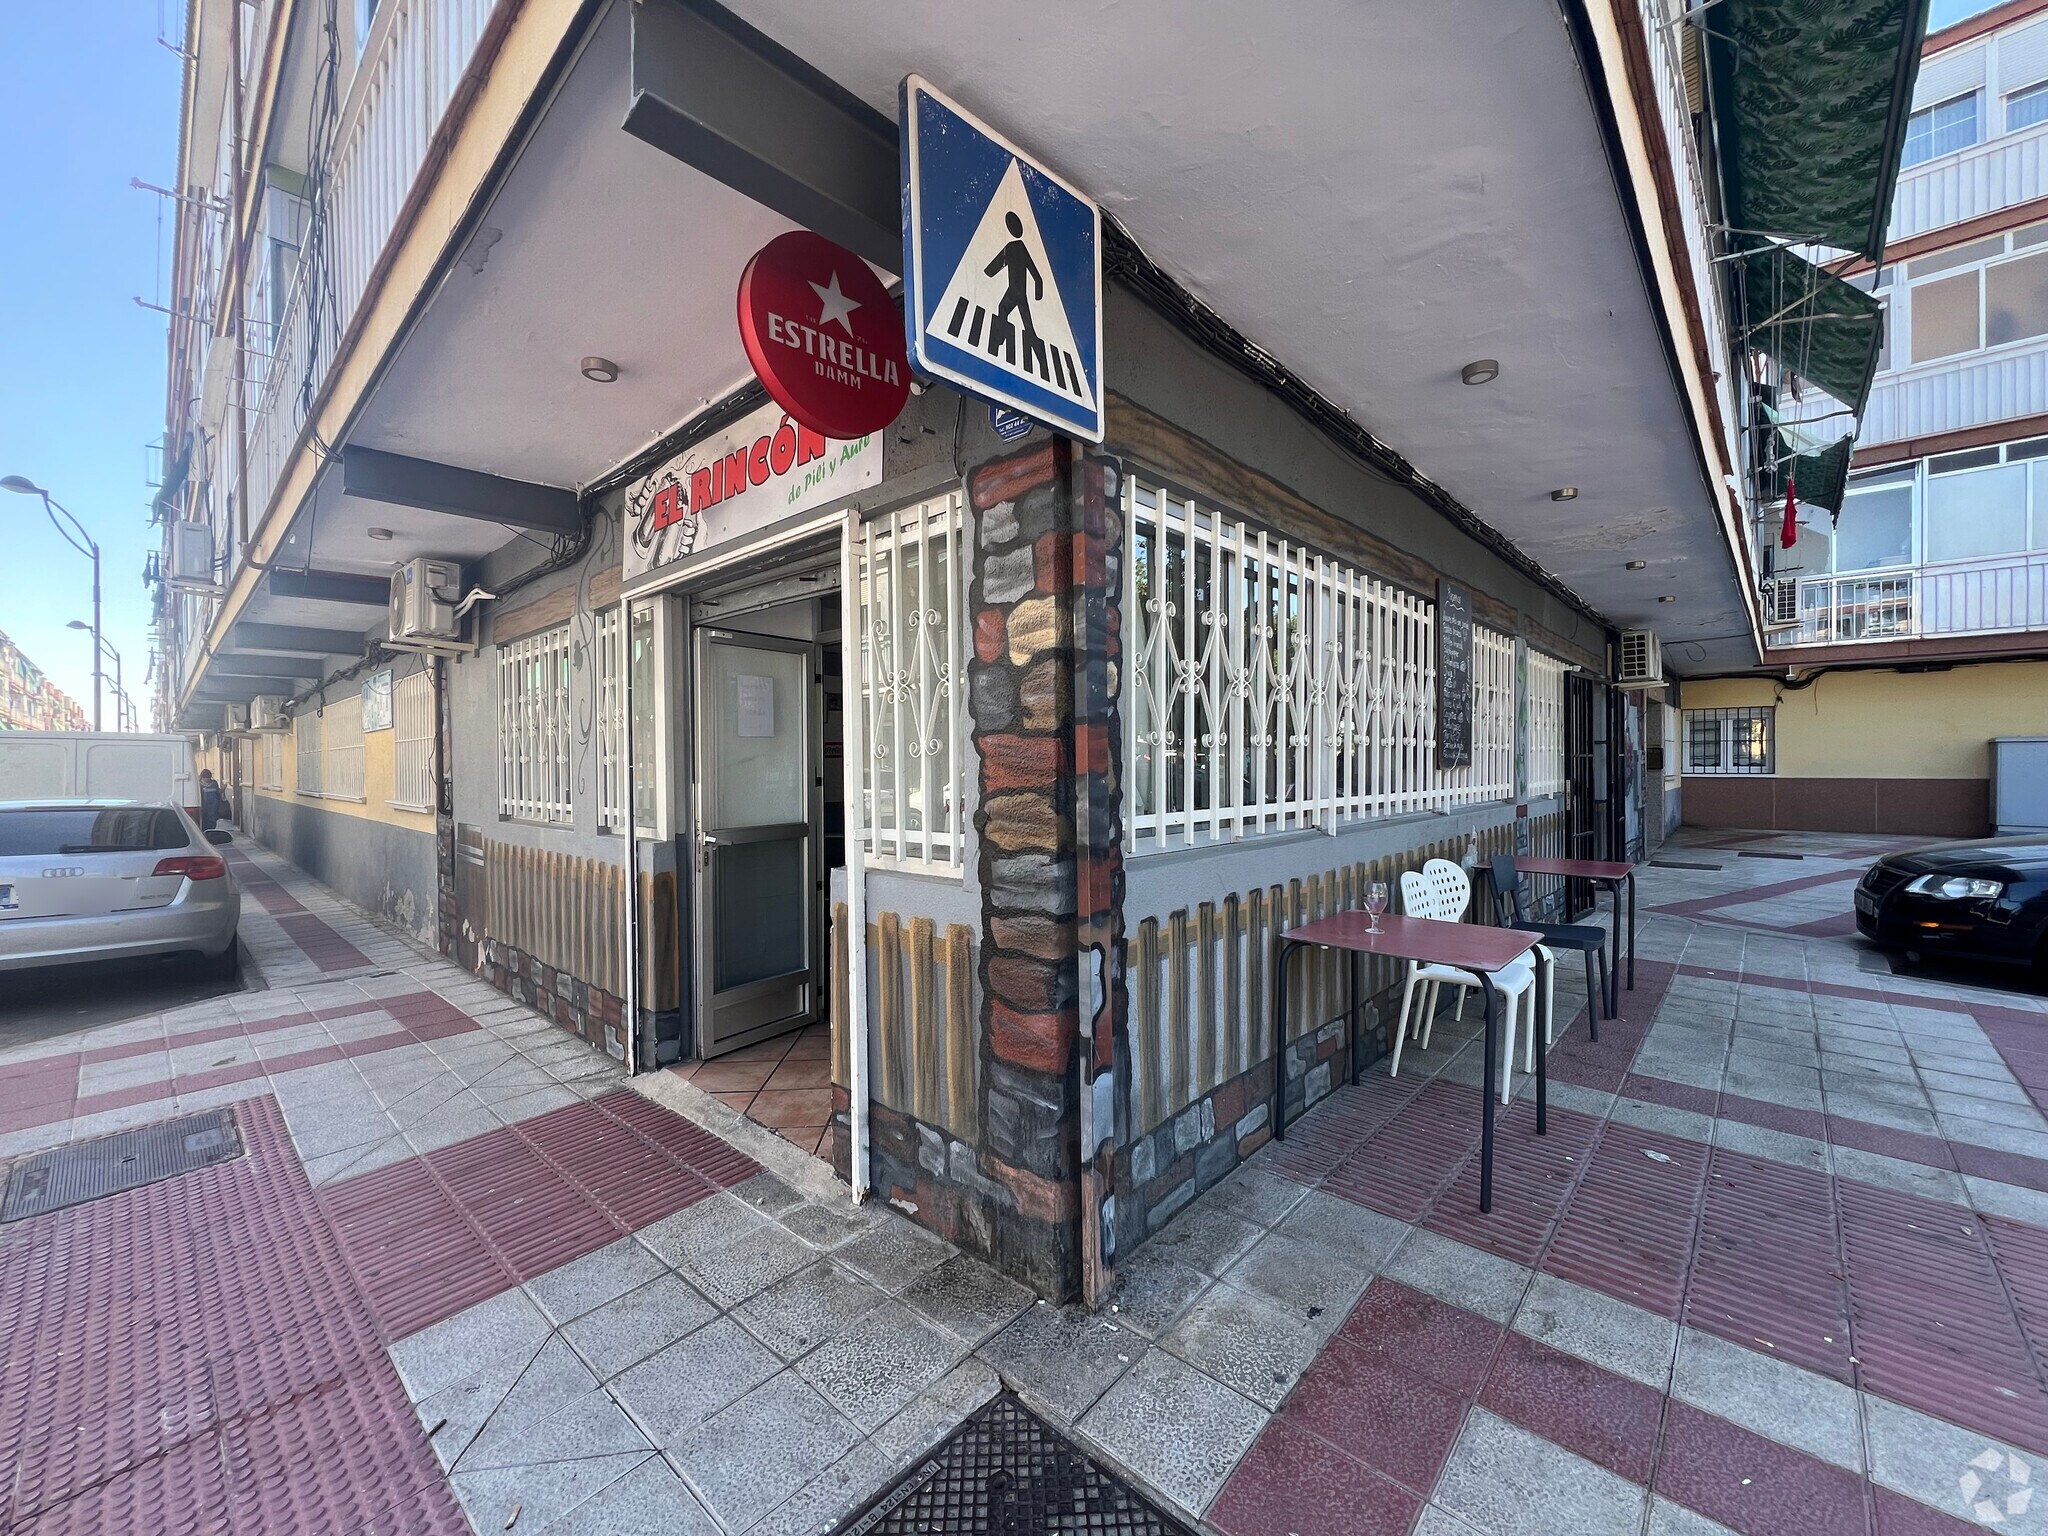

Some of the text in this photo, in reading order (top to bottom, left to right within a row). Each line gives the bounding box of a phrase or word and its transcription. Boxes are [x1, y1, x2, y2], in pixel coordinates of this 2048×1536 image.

[768, 312, 899, 387] ESTRELLA
[815, 361, 861, 390] DAMM
[654, 414, 826, 532] EL RINCÓN
[788, 484, 801, 504] de
[804, 461, 825, 492] Pili
[829, 457, 837, 477] y
[880, 1482, 914, 1512] EN-124
